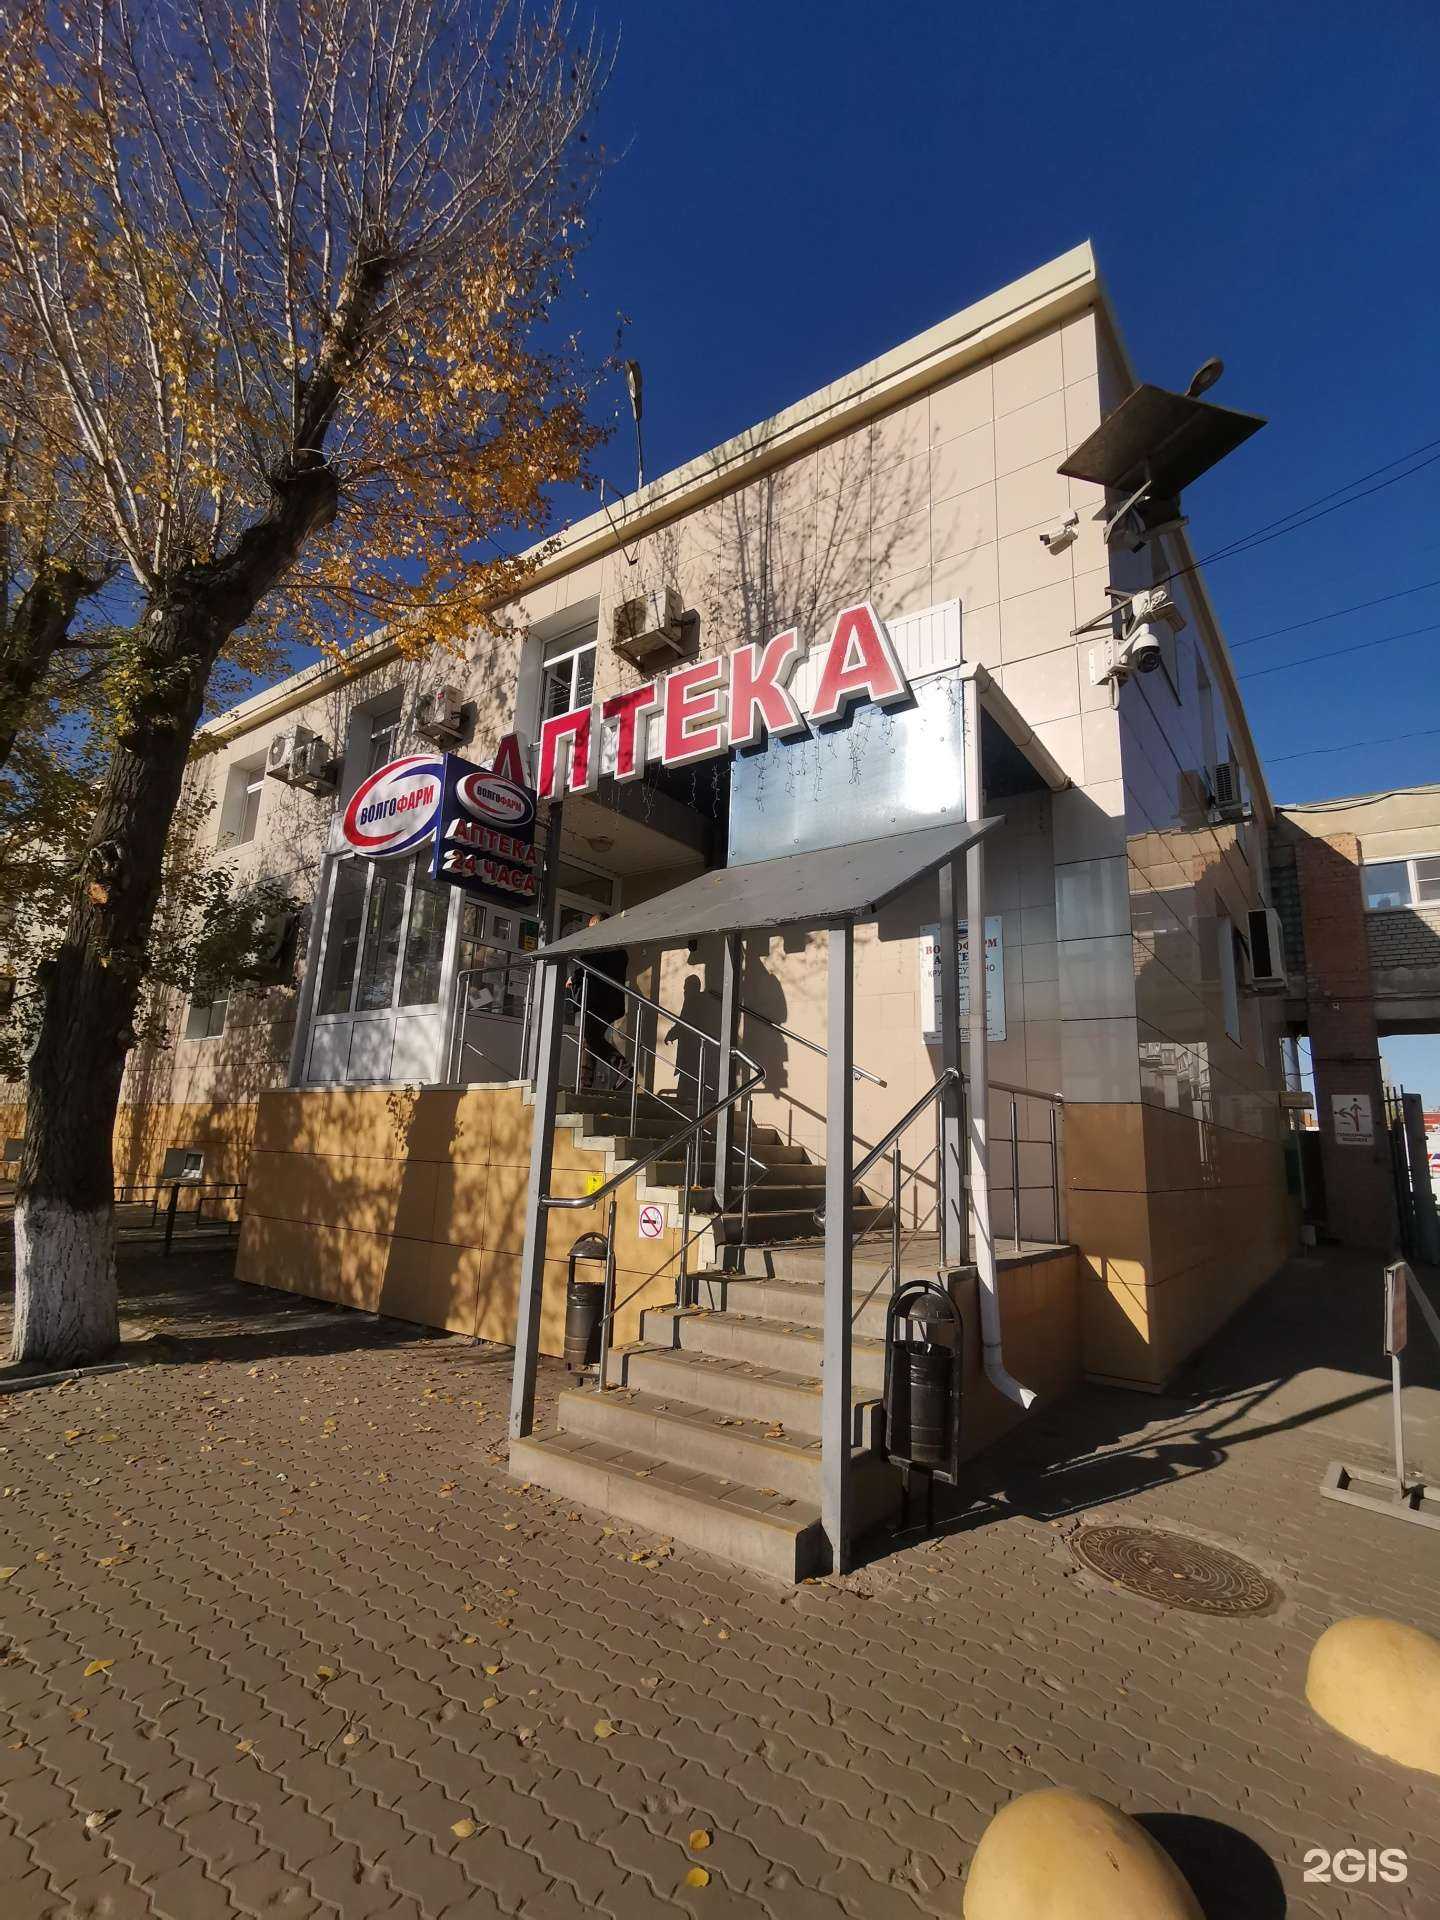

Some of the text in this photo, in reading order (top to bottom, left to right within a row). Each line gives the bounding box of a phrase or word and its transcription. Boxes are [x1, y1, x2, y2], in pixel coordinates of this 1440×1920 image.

[494, 601, 912, 799] АПТЕКА
[360, 784, 434, 825] ВОЛГОФАРМ
[477, 785, 523, 812] ВОЛГОФАРМ
[448, 819, 537, 864] АПТЕКА
[446, 850, 537, 892] 24 ЧАСА
